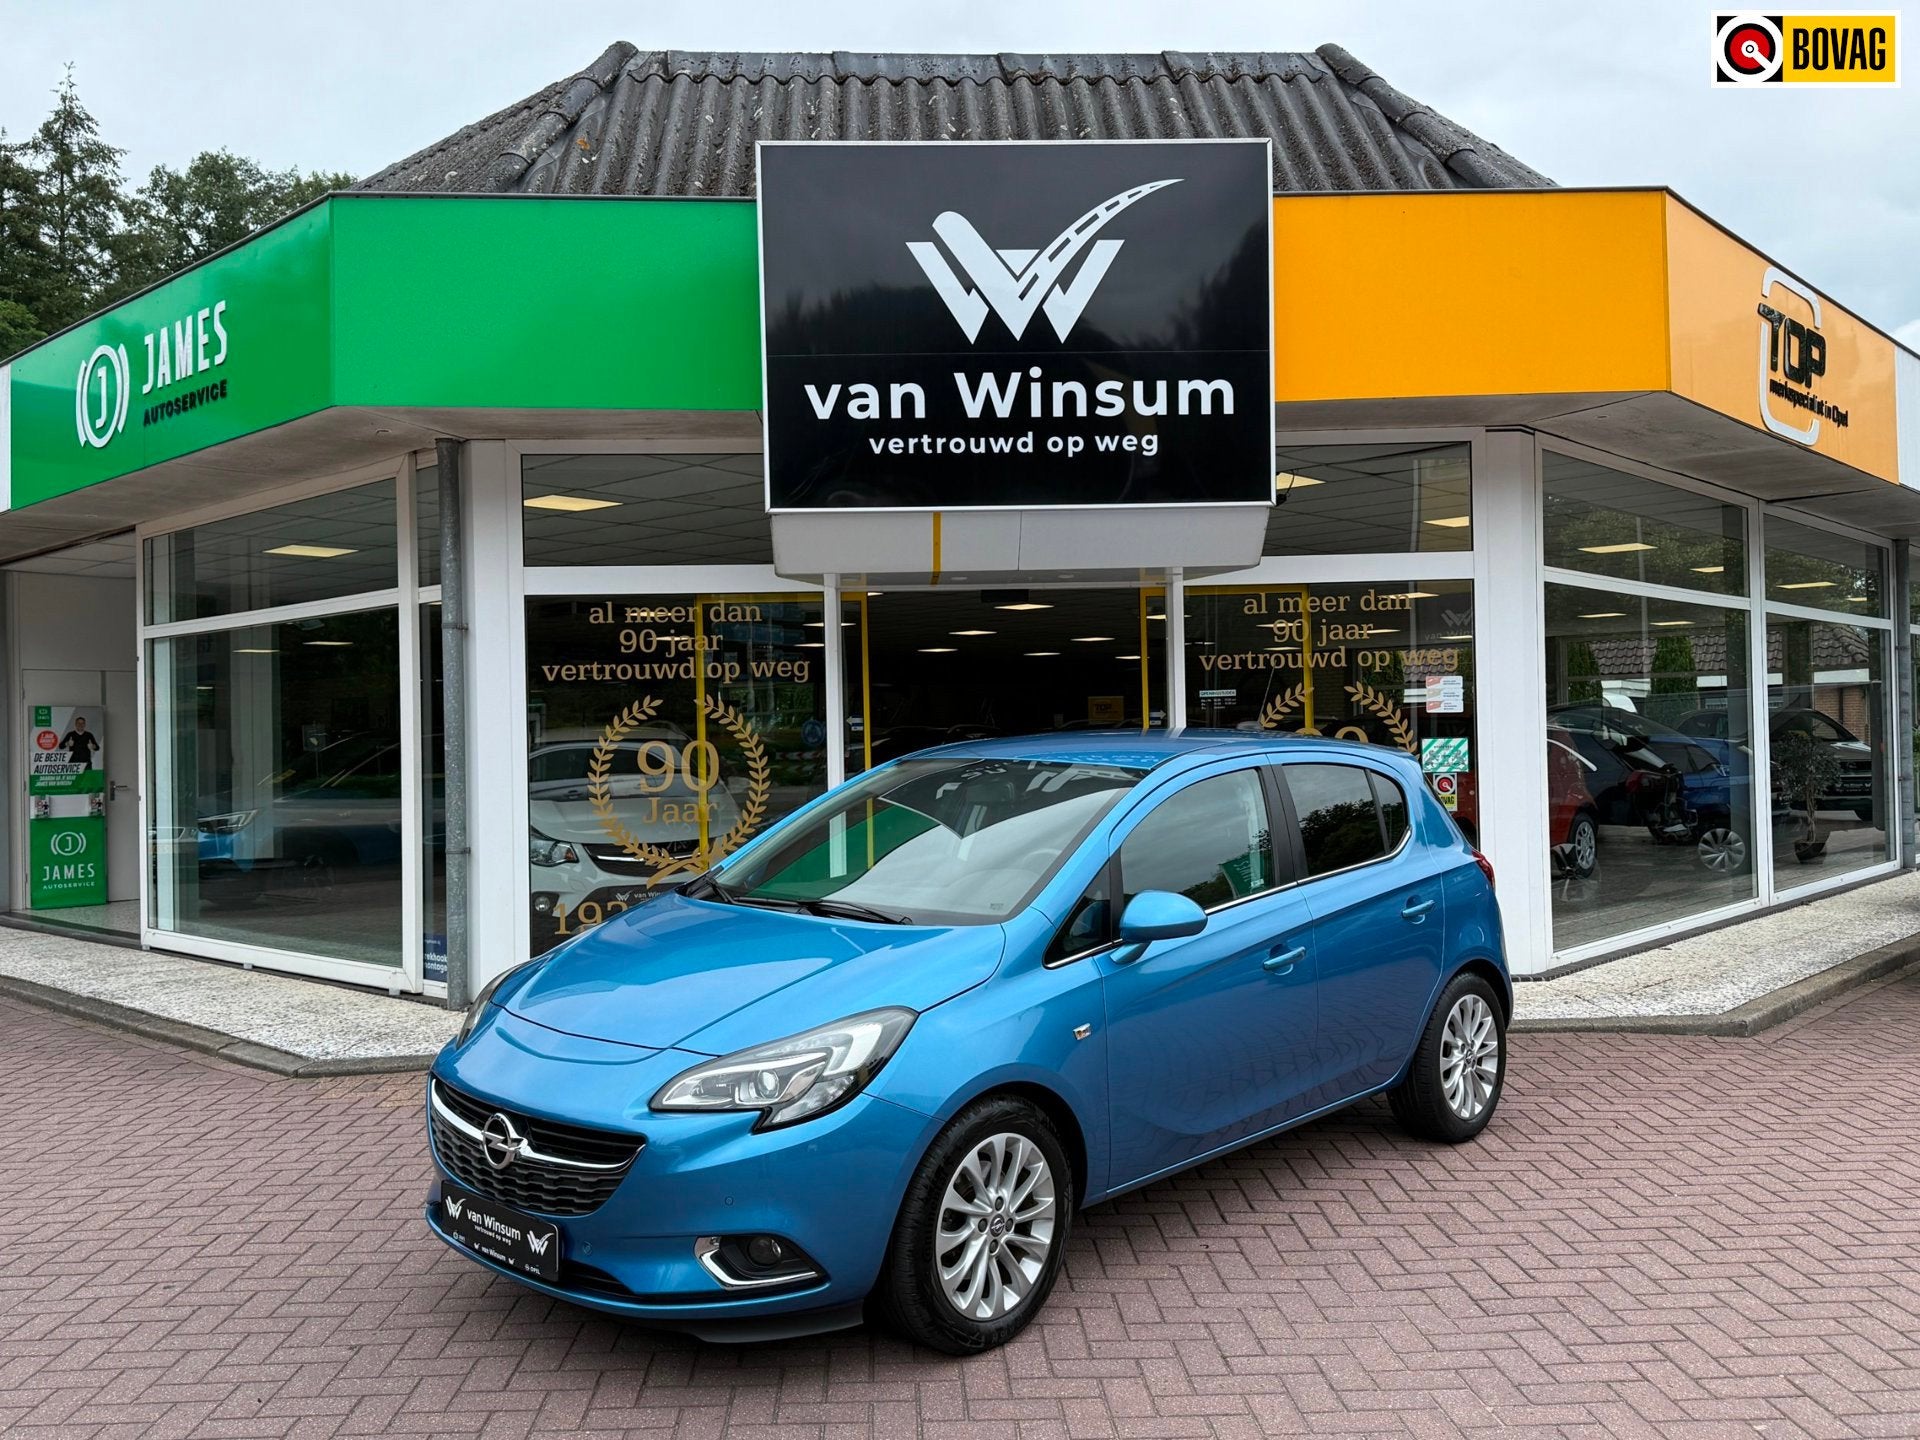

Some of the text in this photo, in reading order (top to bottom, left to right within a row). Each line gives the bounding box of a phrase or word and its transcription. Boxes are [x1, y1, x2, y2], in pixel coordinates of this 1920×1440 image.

[142, 300, 227, 395] JAMES
[1757, 302, 1826, 389] TOP
[143, 379, 228, 427] AUTOSERVICE
[804, 366, 1235, 420] van Winsum
[868, 432, 1159, 458] vertrouwd op weg
[588, 601, 763, 624] al meer dan
[1243, 590, 1413, 614] al meer dan
[618, 628, 723, 658] 90 jaar
[1272, 618, 1374, 647] 90 jaar
[541, 657, 811, 684] vertrouwd op weg
[1199, 645, 1460, 672] vertrouwd op weg
[33, 752, 67, 763] DE BESTE
[33, 764, 82, 774] AUTOSERVICE
[636, 740, 720, 793] 90
[642, 797, 719, 825] Jaar
[42, 863, 96, 881] JAMES
[43, 881, 95, 890] AUTOSERVICE
[466, 1208, 482, 1225] van
[483, 1213, 521, 1241] Winsum
